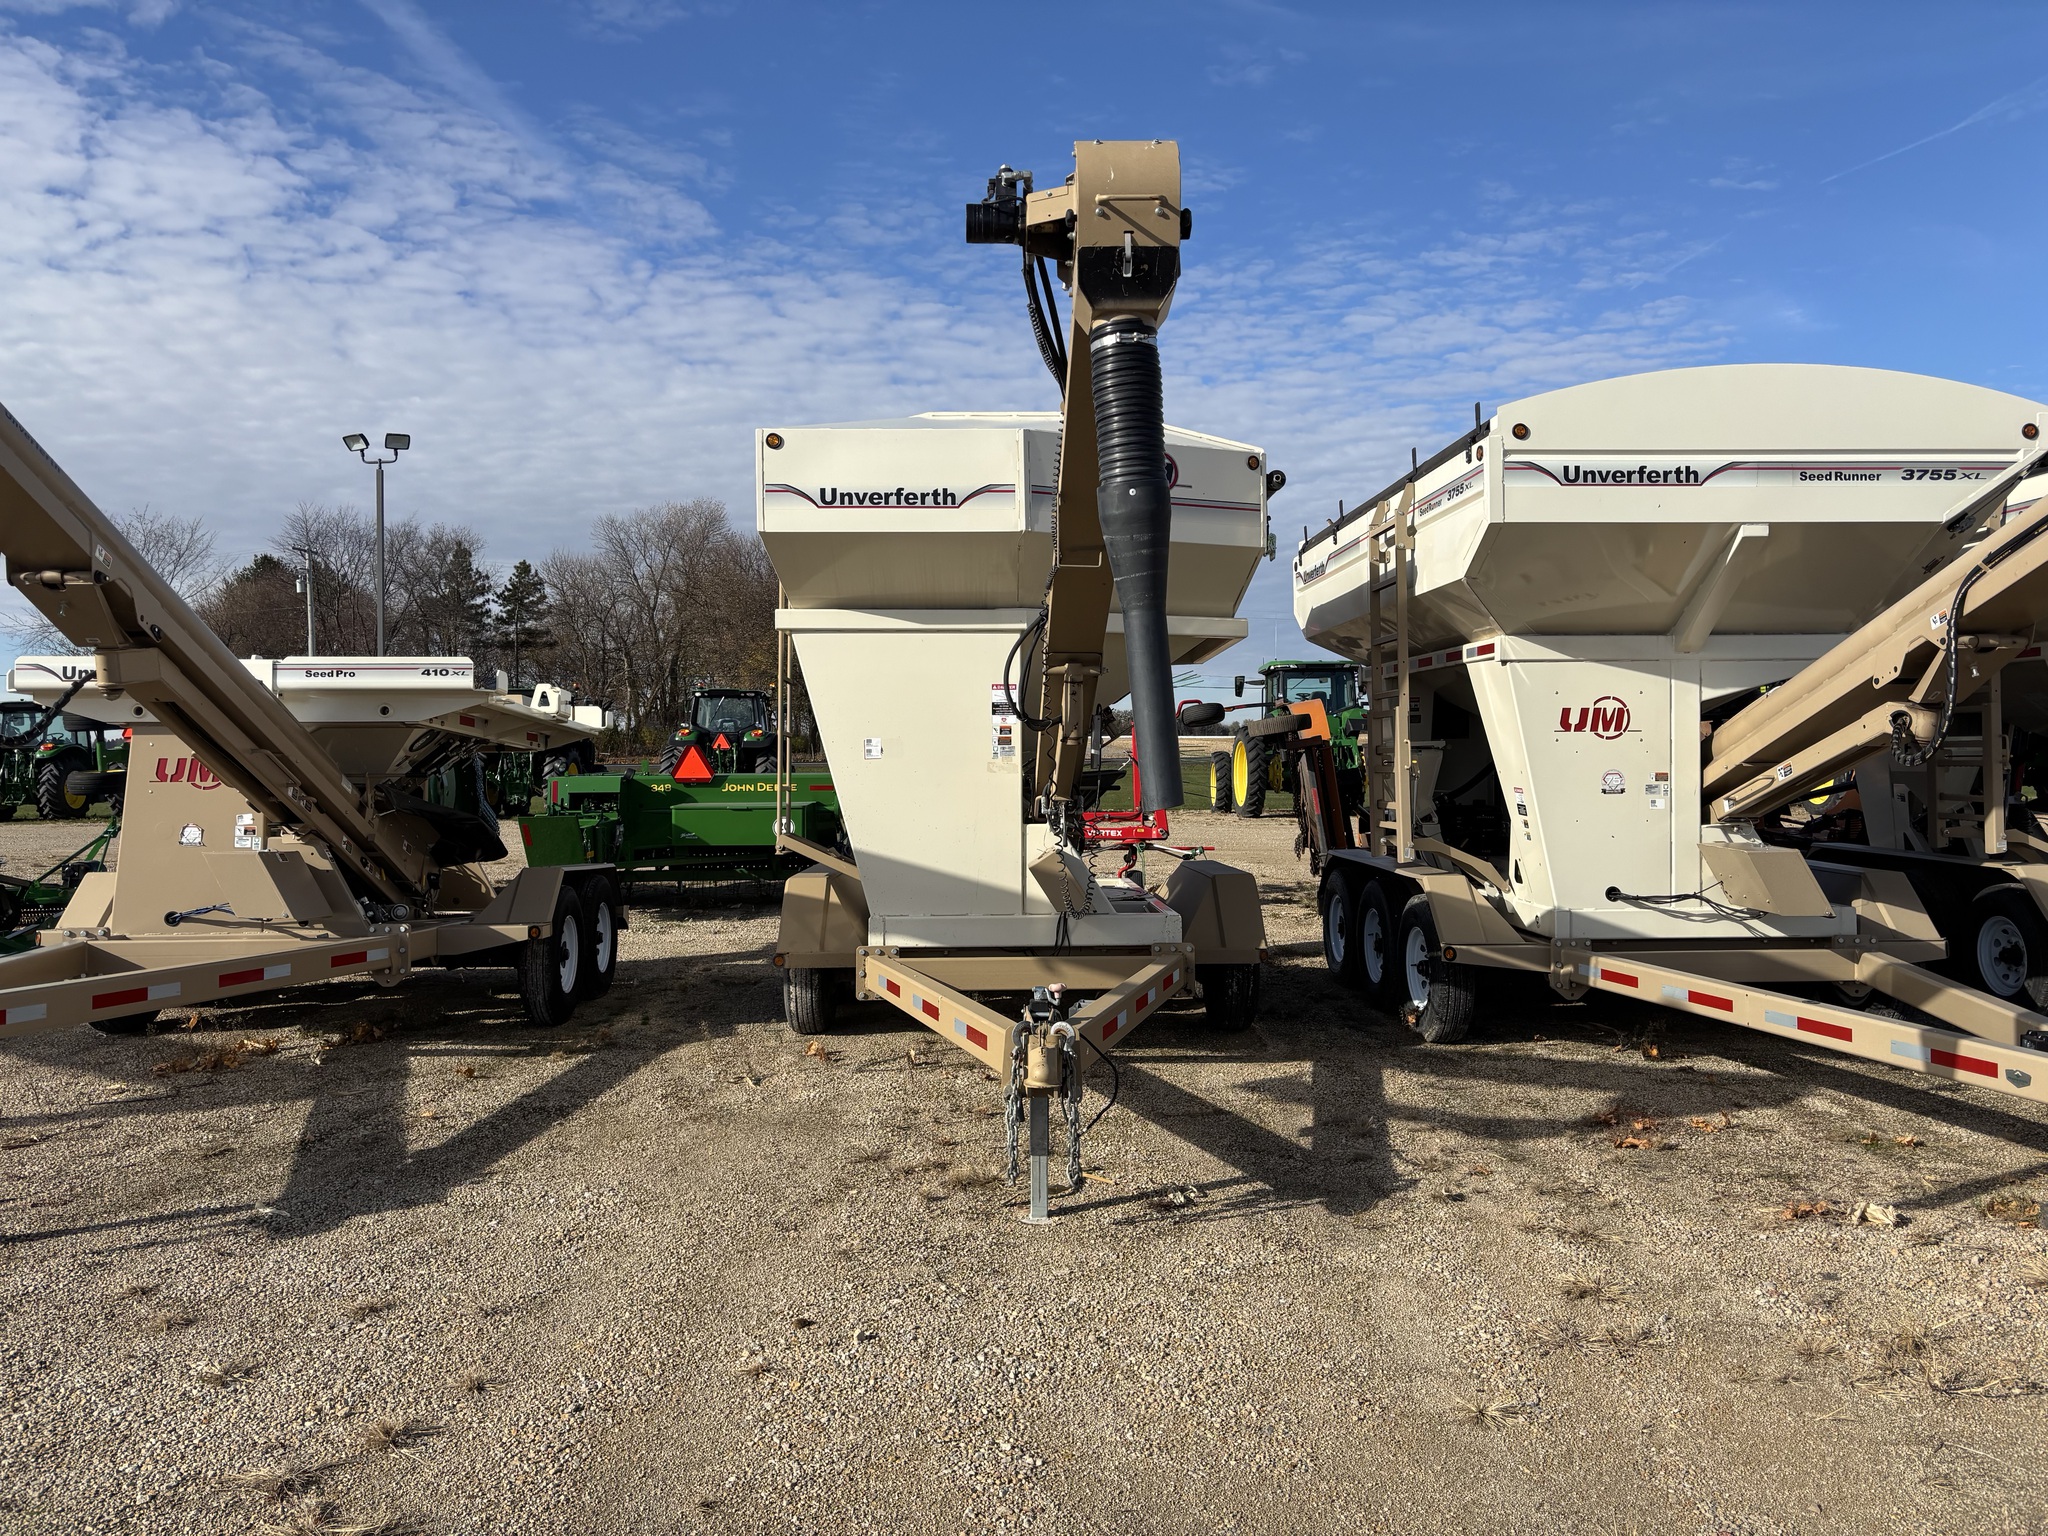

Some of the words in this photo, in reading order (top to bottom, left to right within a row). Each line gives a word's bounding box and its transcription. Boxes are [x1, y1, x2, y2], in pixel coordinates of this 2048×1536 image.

[1563, 465, 1700, 484] Unverferth
[1799, 471, 1832, 481] Seed
[1834, 471, 1882, 481] Runner
[819, 487, 957, 506] Unverferth
[1303, 560, 1325, 583] Unverferth
[305, 670, 334, 678] Seed
[336, 670, 356, 678] Pro
[1559, 706, 1626, 733] UM
[650, 783, 672, 793] 348
[722, 782, 754, 792] JOHN
